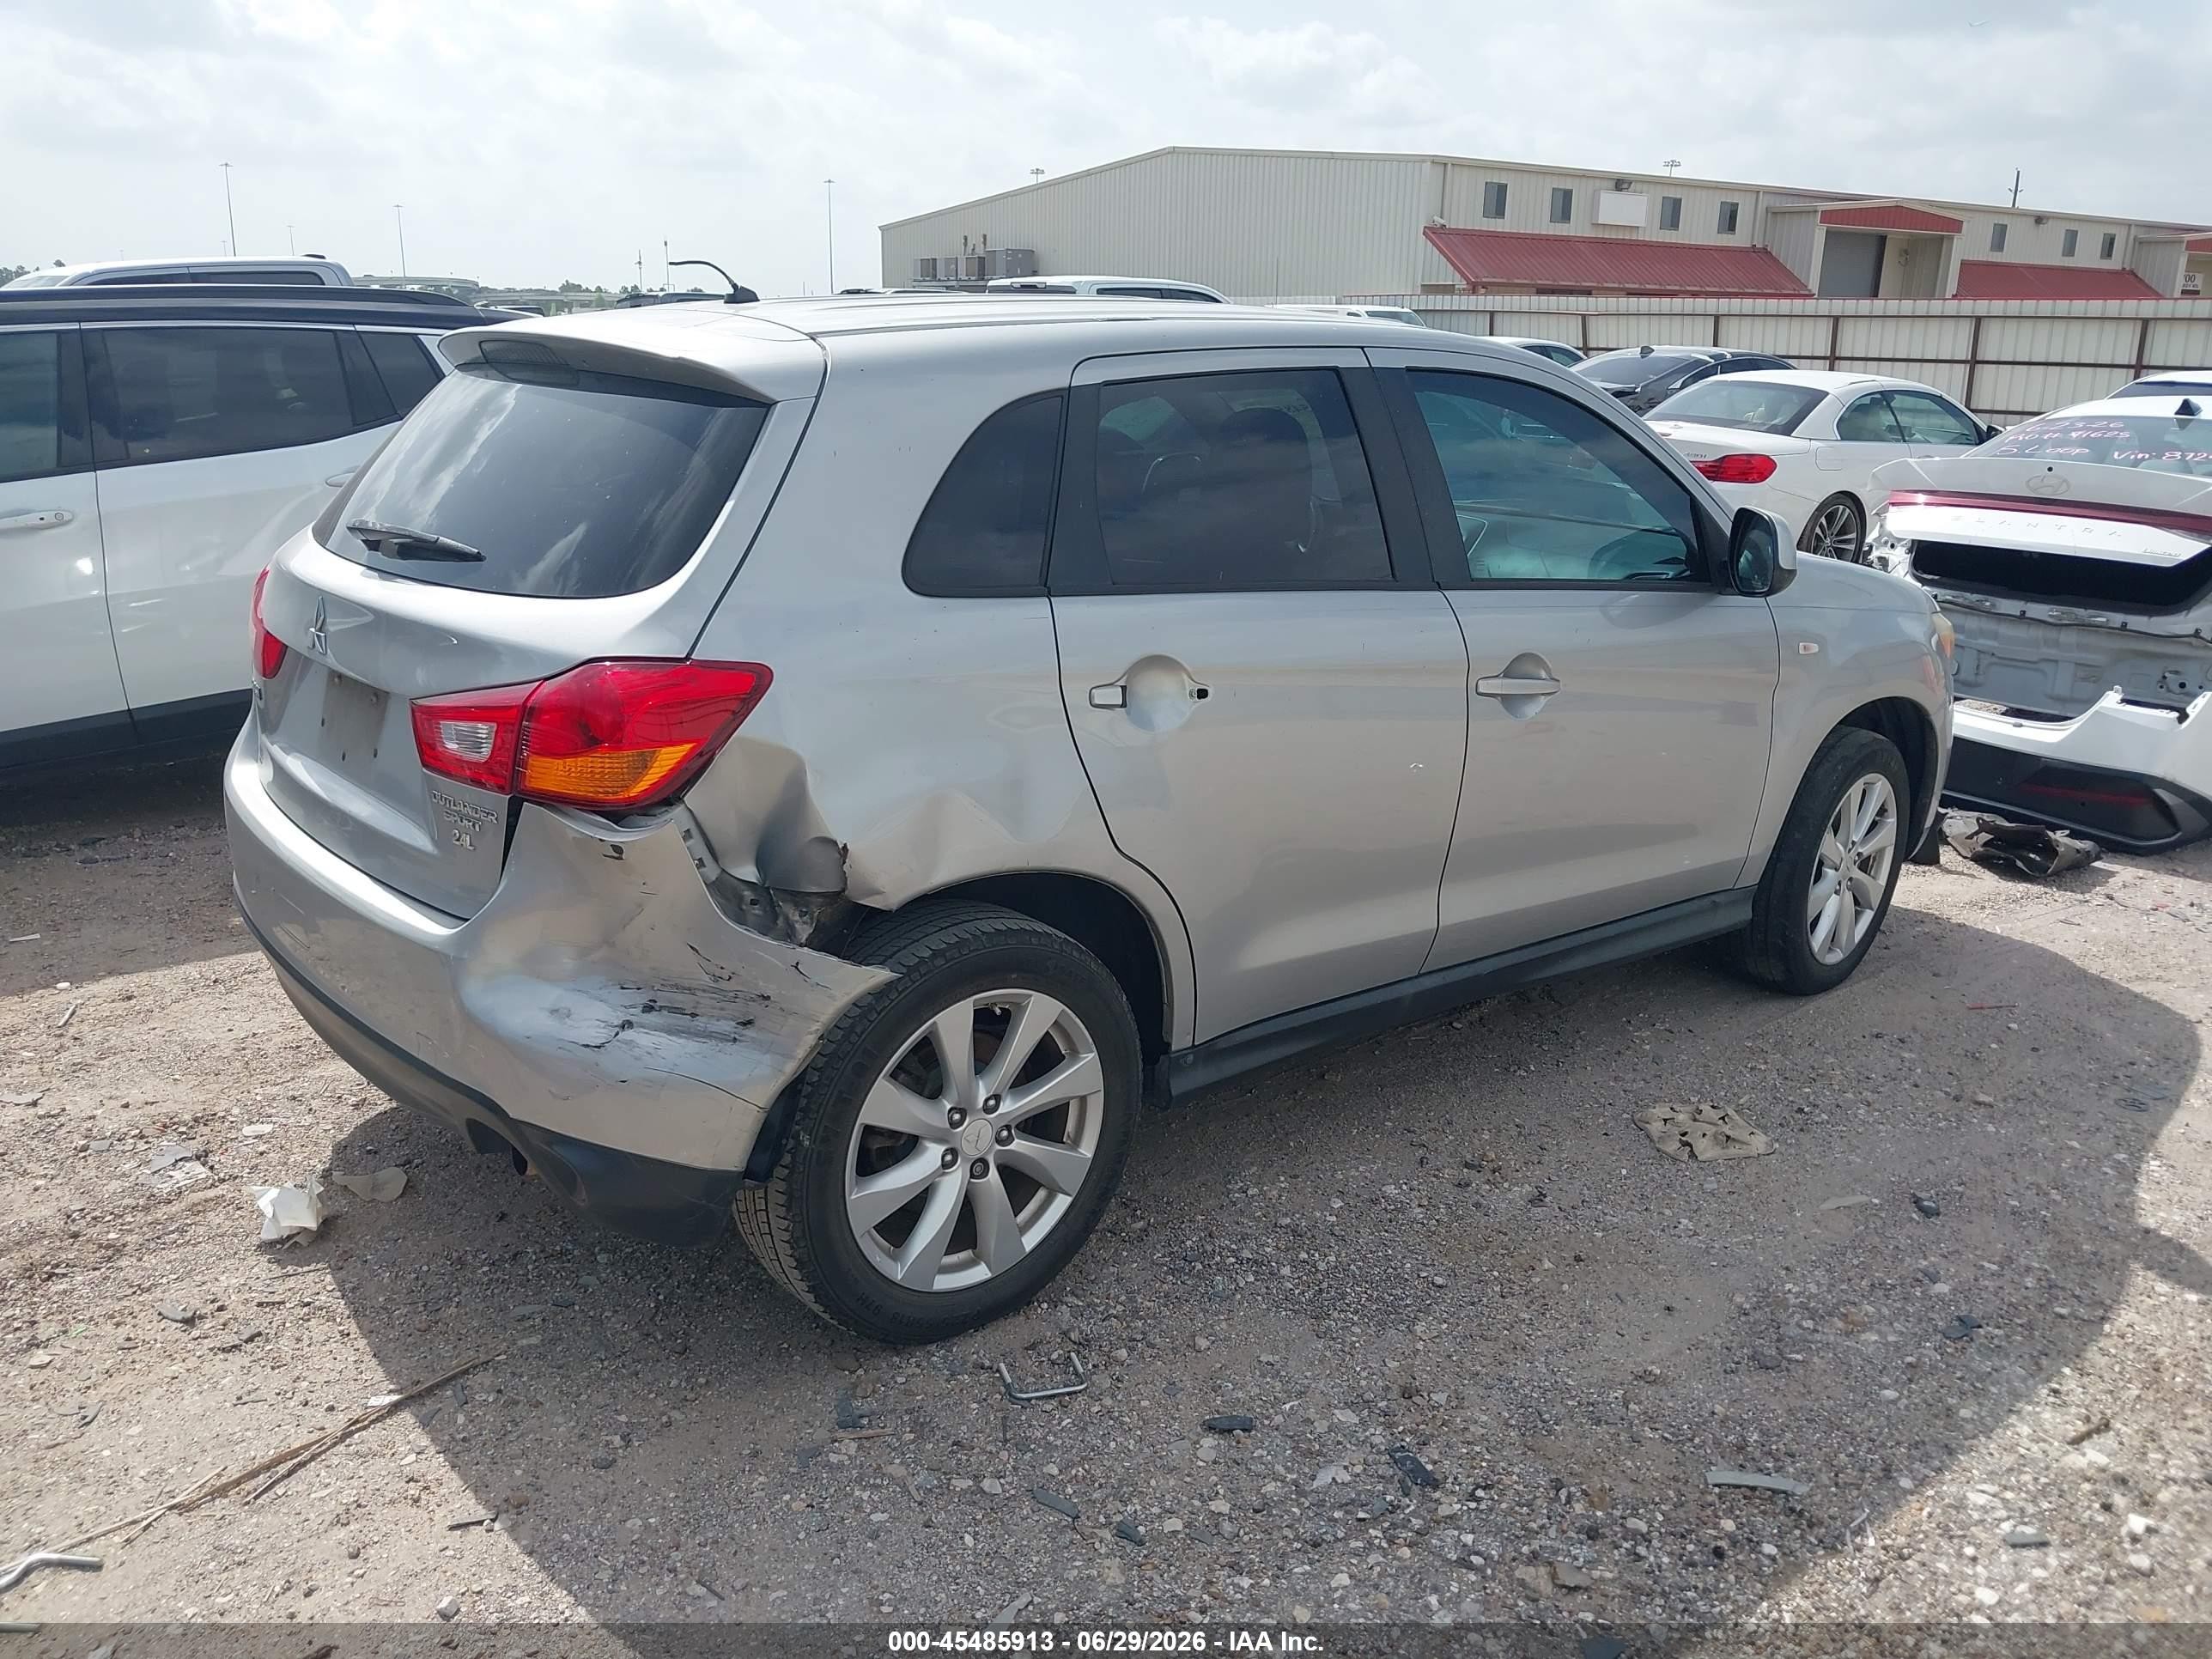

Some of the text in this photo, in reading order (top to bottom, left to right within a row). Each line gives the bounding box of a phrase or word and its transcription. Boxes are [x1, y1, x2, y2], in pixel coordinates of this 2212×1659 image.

[2184, 274, 2196, 283] 00
[2161, 451, 2212, 461] 872
[1950, 515, 2122, 537] ELANTRA
[431, 790, 498, 824] OUTLANDER
[442, 810, 483, 832] SPORT
